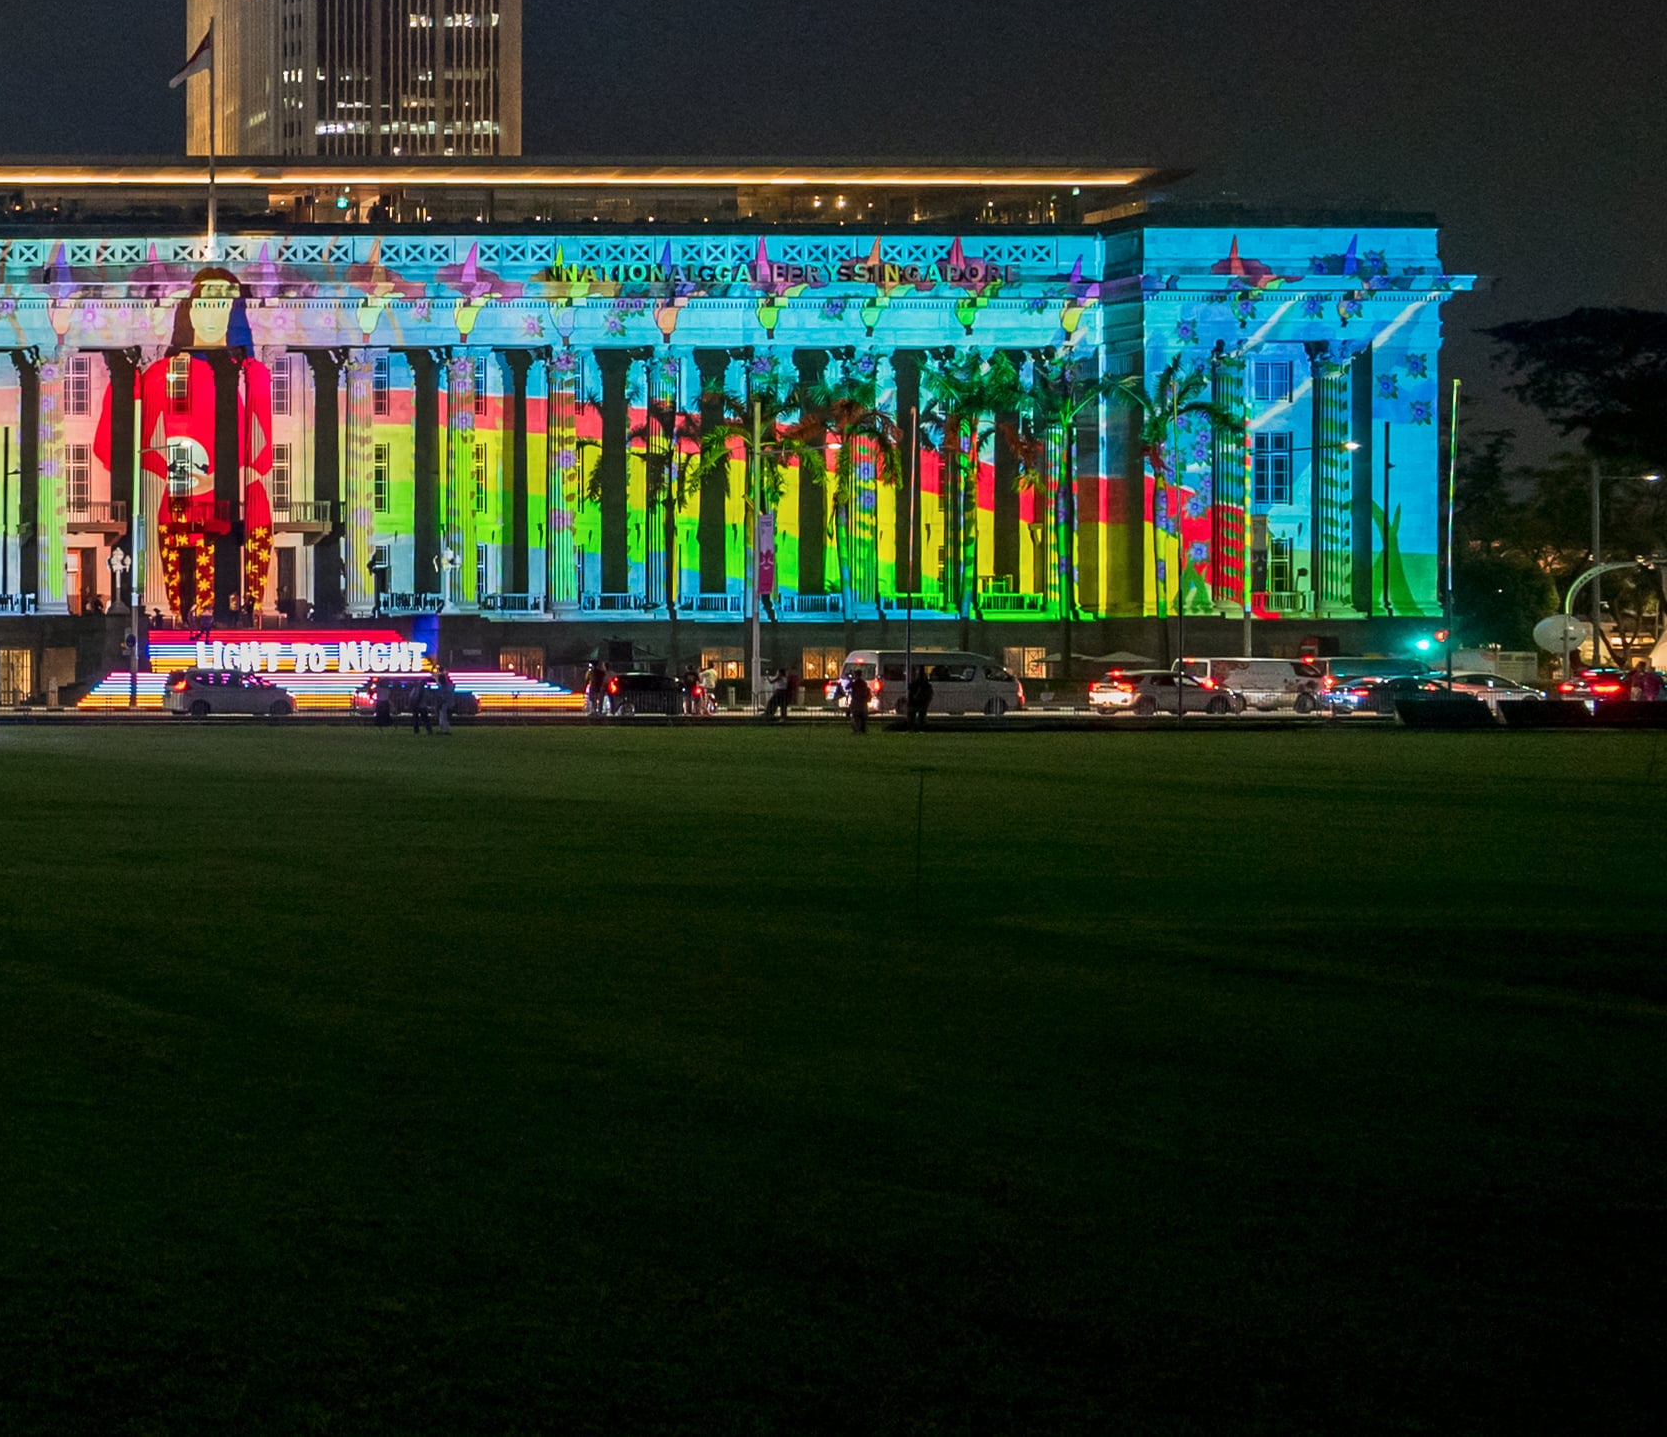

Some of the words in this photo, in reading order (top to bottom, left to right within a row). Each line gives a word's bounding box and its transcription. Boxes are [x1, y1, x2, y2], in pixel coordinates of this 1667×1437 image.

[560, 263, 697, 282] NATIONAL
[713, 263, 843, 282] GALLERY
[851, 264, 1021, 282] SINGAPORE
[196, 641, 281, 672] LIGHT
[291, 642, 325, 673] TO
[338, 641, 427, 673] NIGHT
